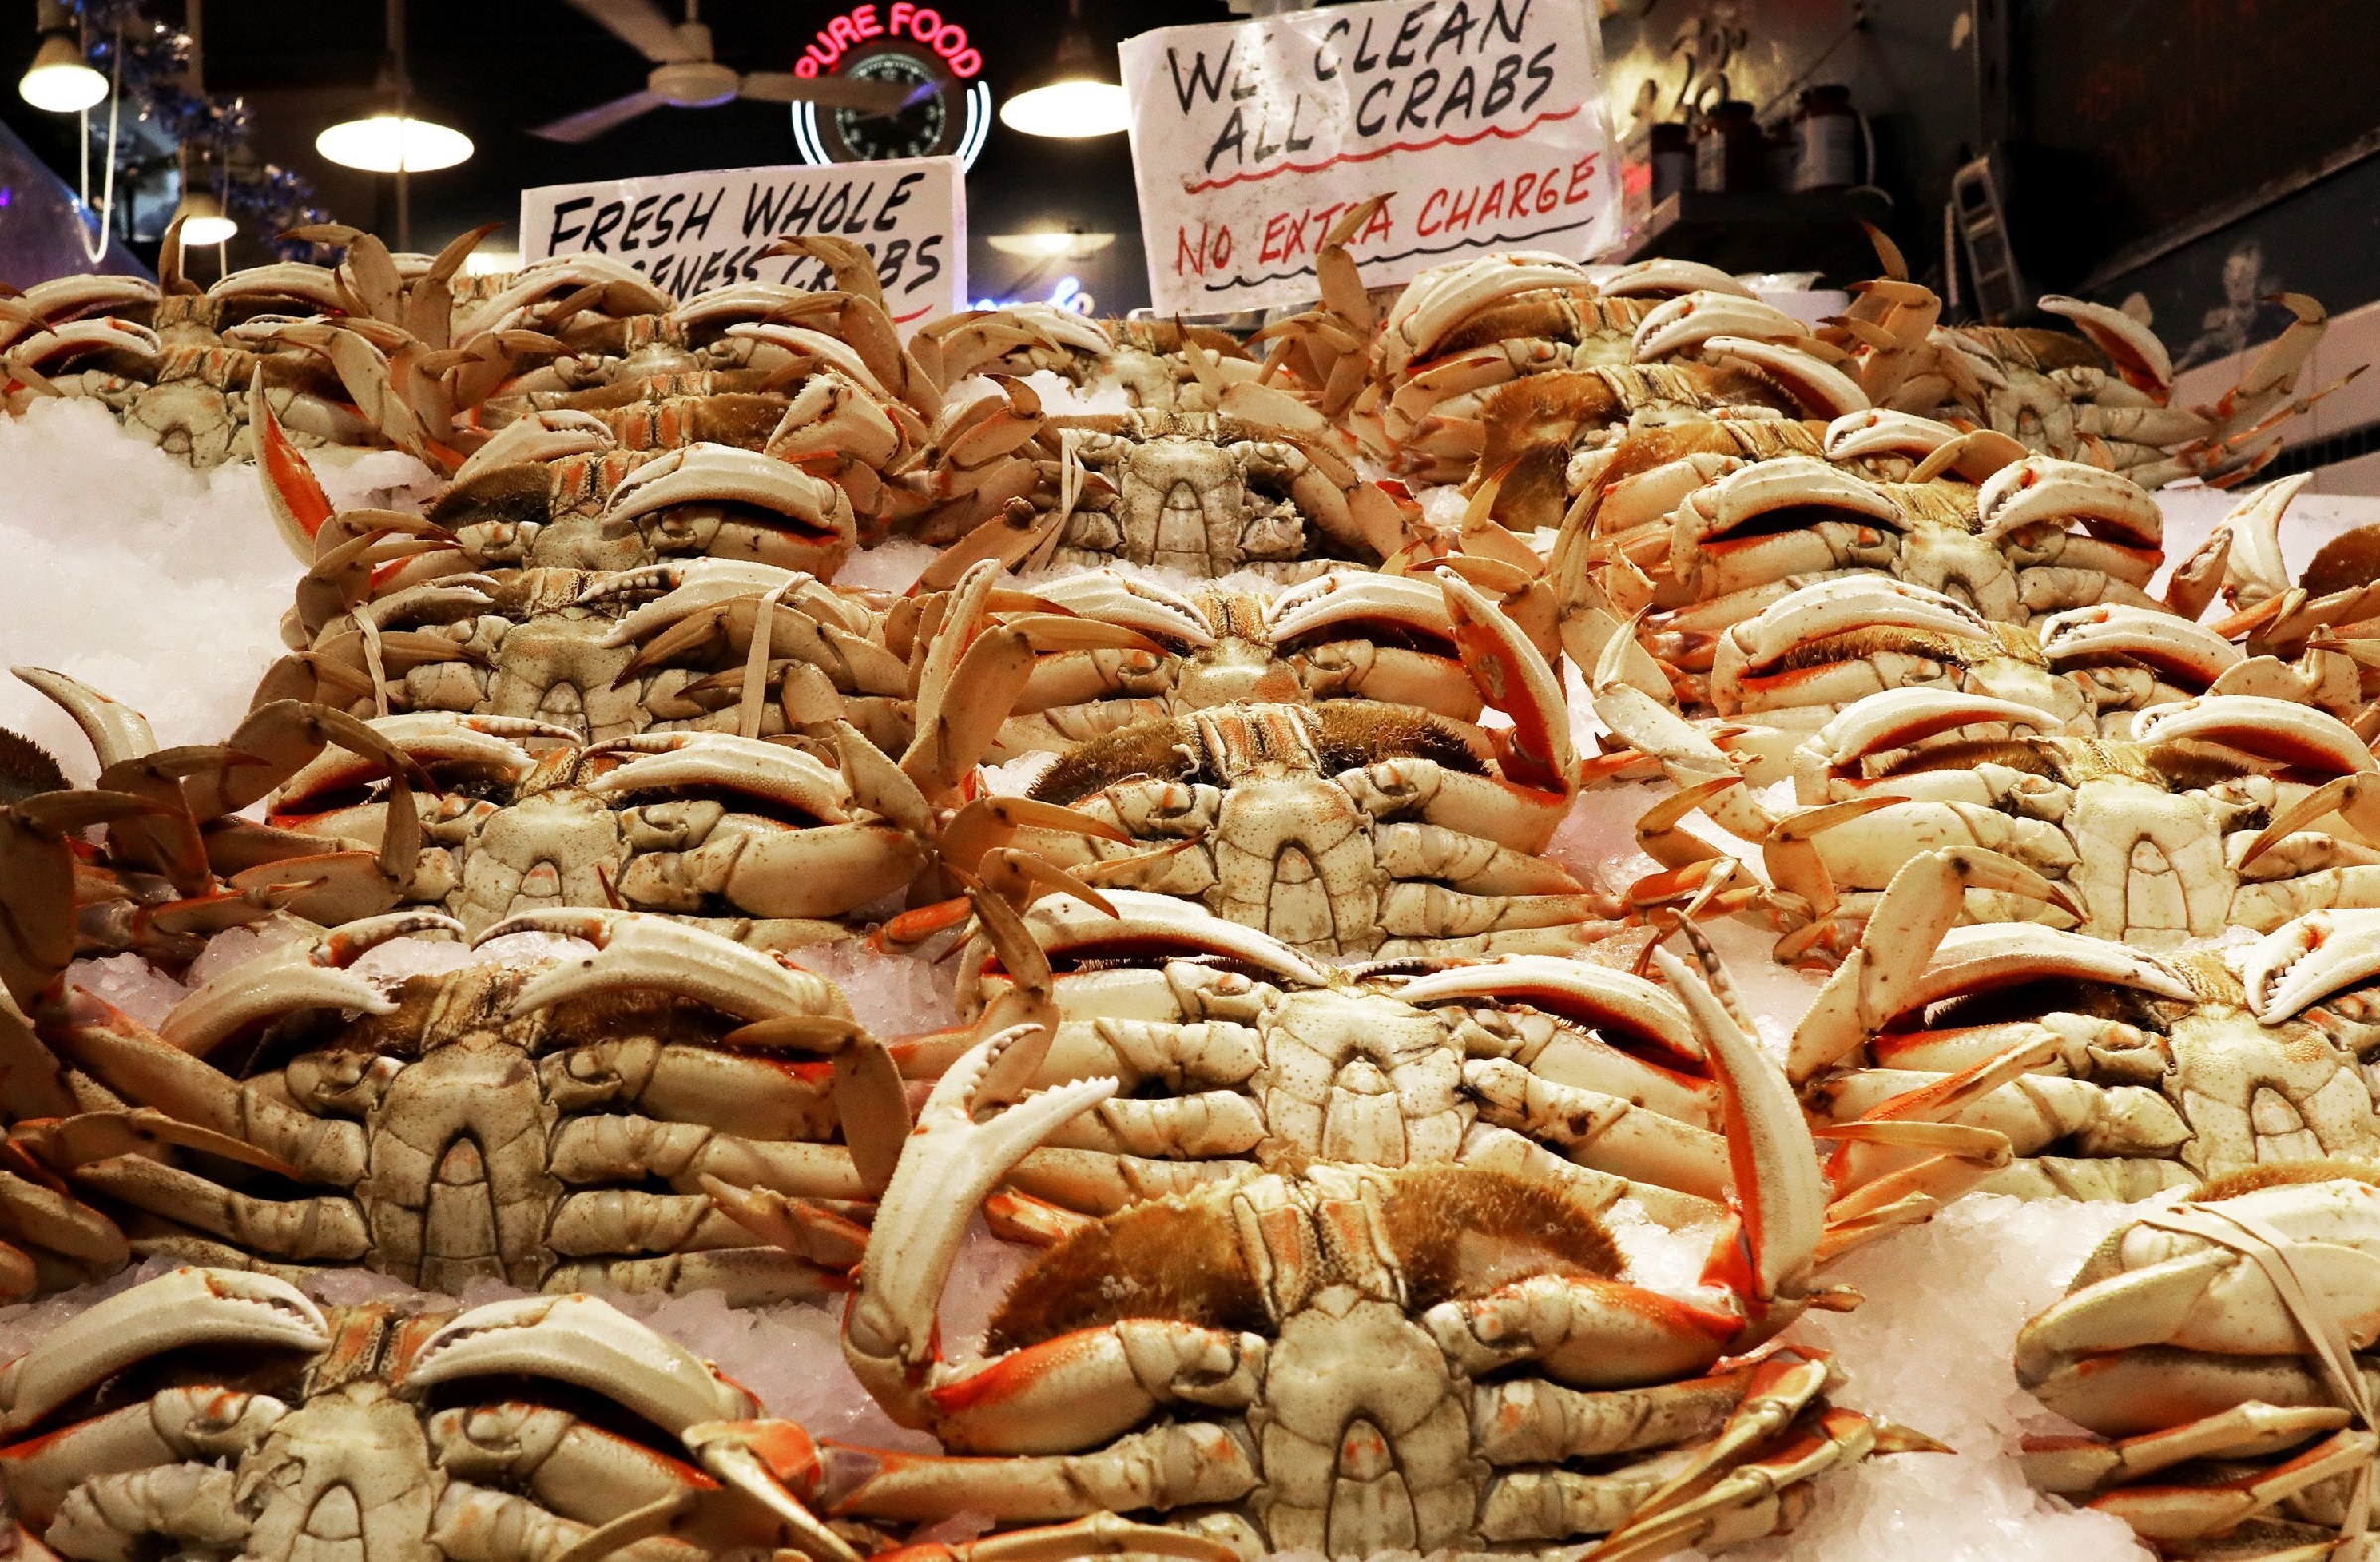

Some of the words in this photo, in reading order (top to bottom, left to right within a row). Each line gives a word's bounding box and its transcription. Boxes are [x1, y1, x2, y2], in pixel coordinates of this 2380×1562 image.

[795, 4, 884, 78] PURE
[890, 2, 983, 78] FOOD
[1314, 0, 1531, 81] CLEAN
[1205, 94, 1314, 174] ALL
[1356, 43, 1557, 137] CRABS
[548, 187, 726, 256] FRESH
[742, 173, 925, 238] WHOLE
[1176, 224, 1232, 277] NO
[1416, 152, 1600, 237] CHARGE
[632, 244, 770, 302] ENESS
